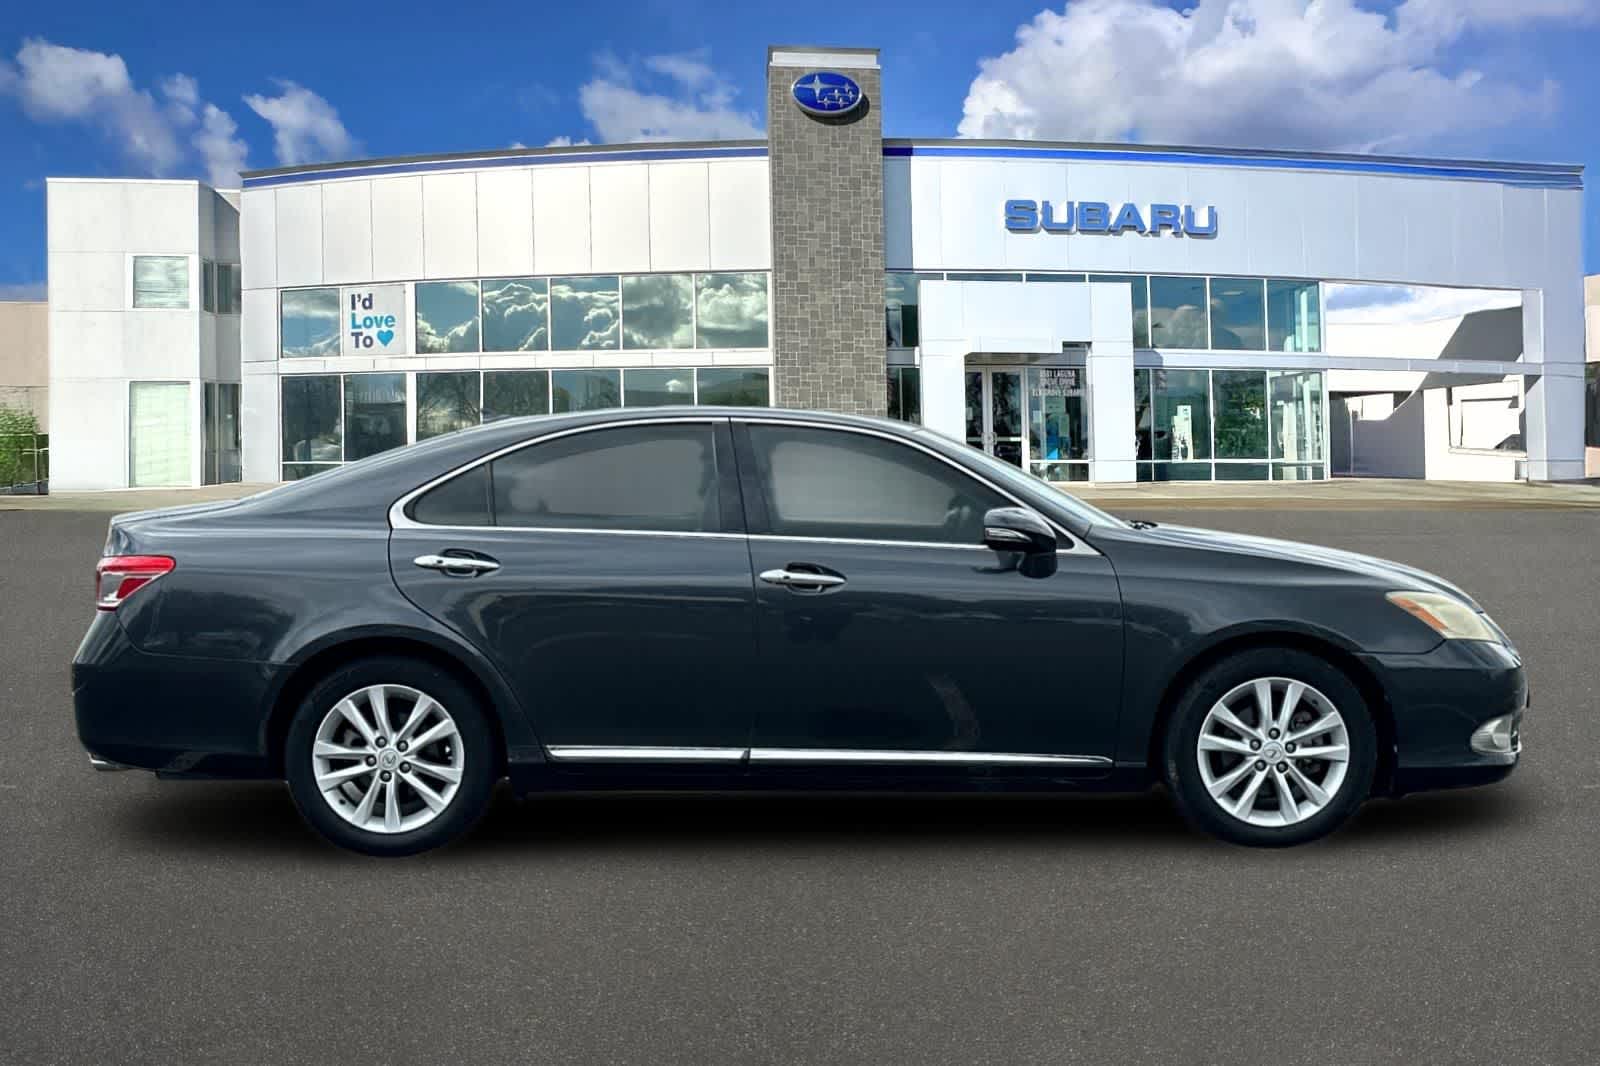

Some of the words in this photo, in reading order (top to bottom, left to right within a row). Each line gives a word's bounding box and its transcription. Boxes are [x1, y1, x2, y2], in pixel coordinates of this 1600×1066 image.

[1005, 199, 1217, 237] SUBARU
[351, 293, 373, 310] I'd
[351, 312, 396, 329] Love
[351, 331, 374, 348] To
